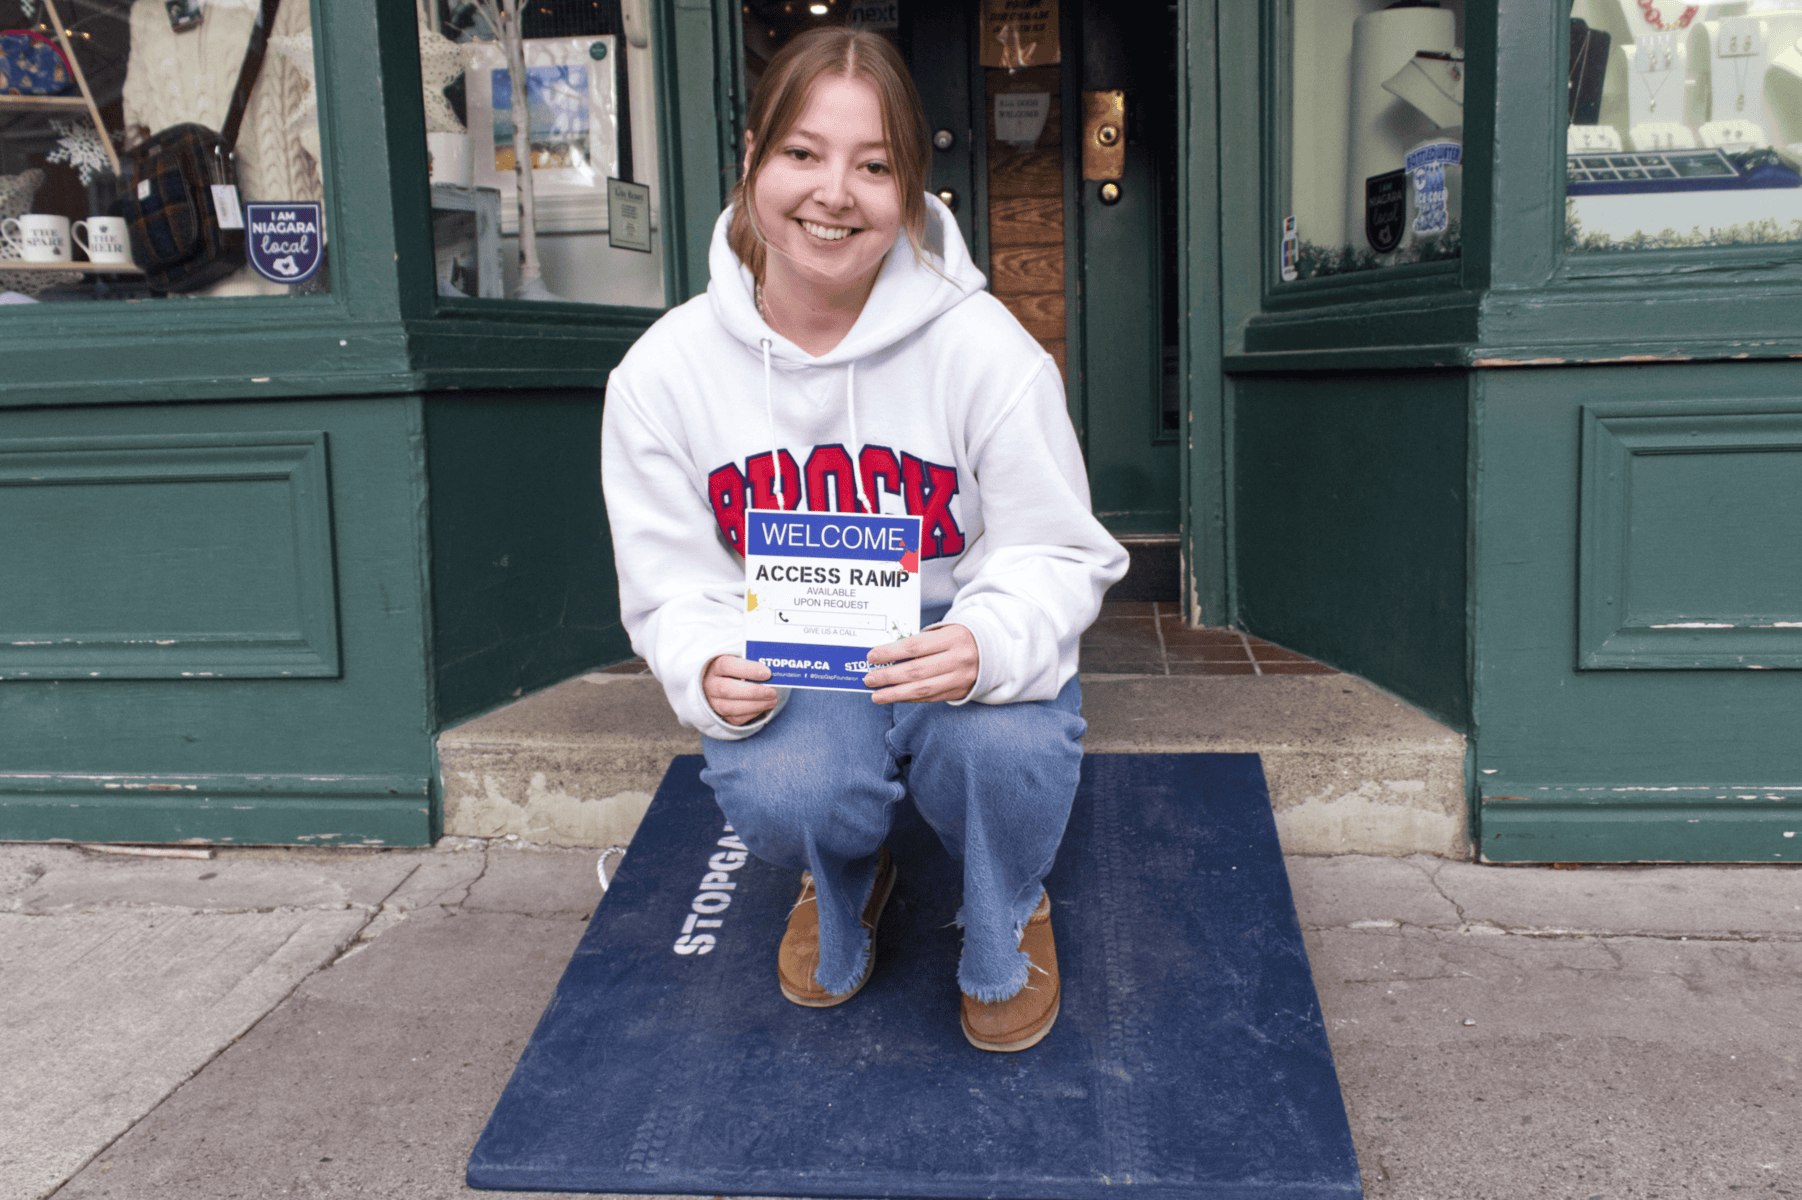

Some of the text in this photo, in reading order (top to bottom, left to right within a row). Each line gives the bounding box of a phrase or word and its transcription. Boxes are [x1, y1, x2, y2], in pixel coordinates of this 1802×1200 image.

[270, 211, 296, 221] I AM
[31, 229, 58, 237] THE
[252, 222, 316, 234] NIAGARA
[94, 235, 117, 243] THE
[260, 234, 309, 255] local
[761, 522, 905, 551] WELCOME
[755, 564, 909, 588] ACCESS RAMP
[806, 586, 856, 597] AVAILABLE
[793, 597, 869, 609] UPON REQUEST
[803, 627, 820, 635] GIVE
[839, 629, 857, 637] CALL
[758, 657, 831, 671] STOPGAP.CA
